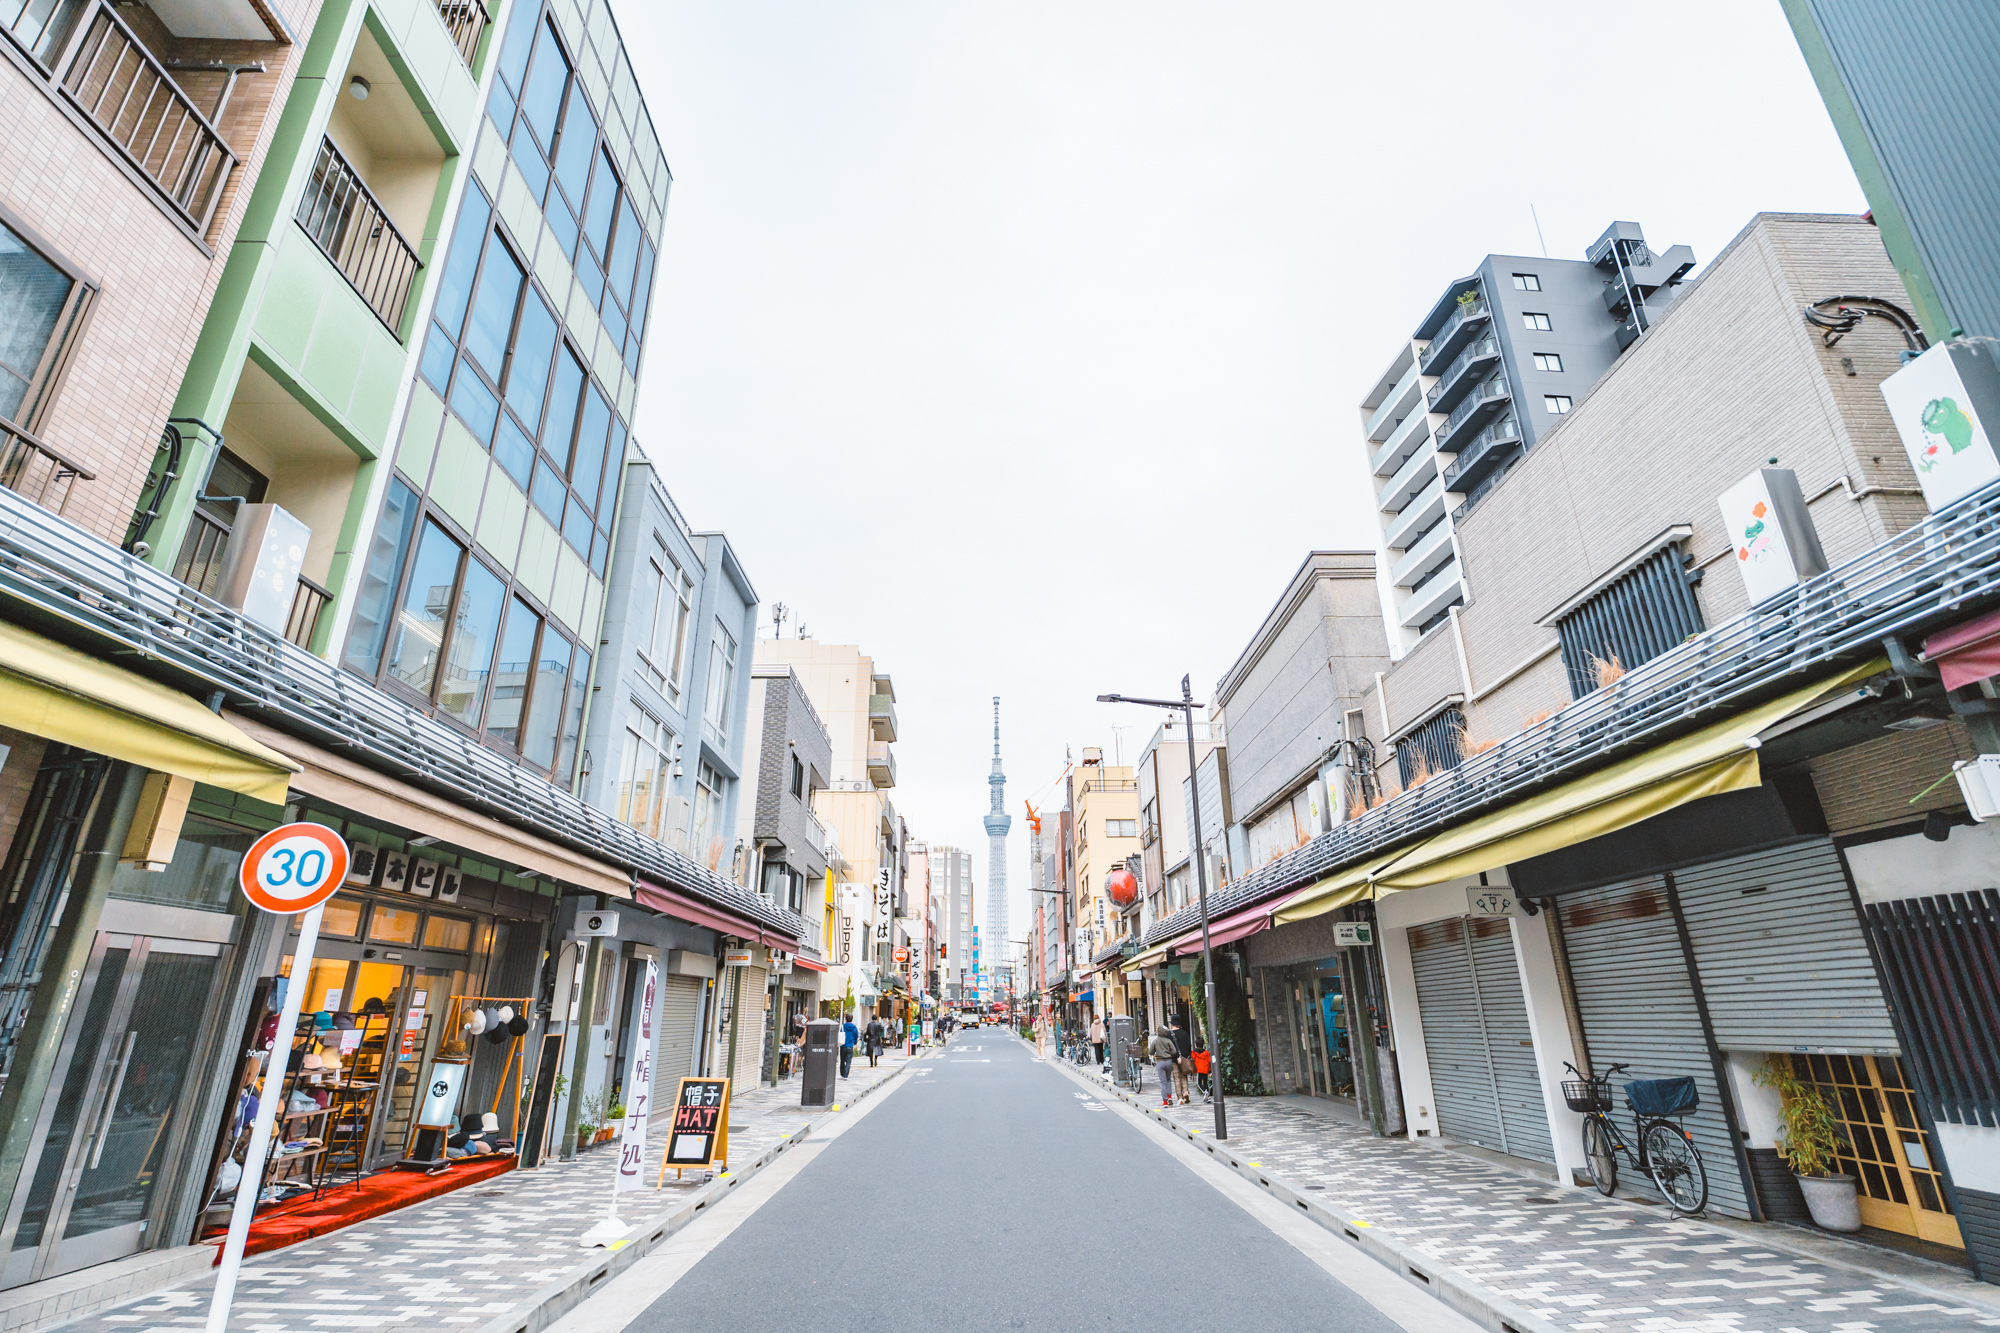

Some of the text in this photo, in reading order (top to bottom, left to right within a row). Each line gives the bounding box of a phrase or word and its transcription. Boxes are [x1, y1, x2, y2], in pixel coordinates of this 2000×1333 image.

[266, 849, 326, 888] 30
[685, 1085, 719, 1107] 帽子
[676, 1108, 717, 1128] HAT
